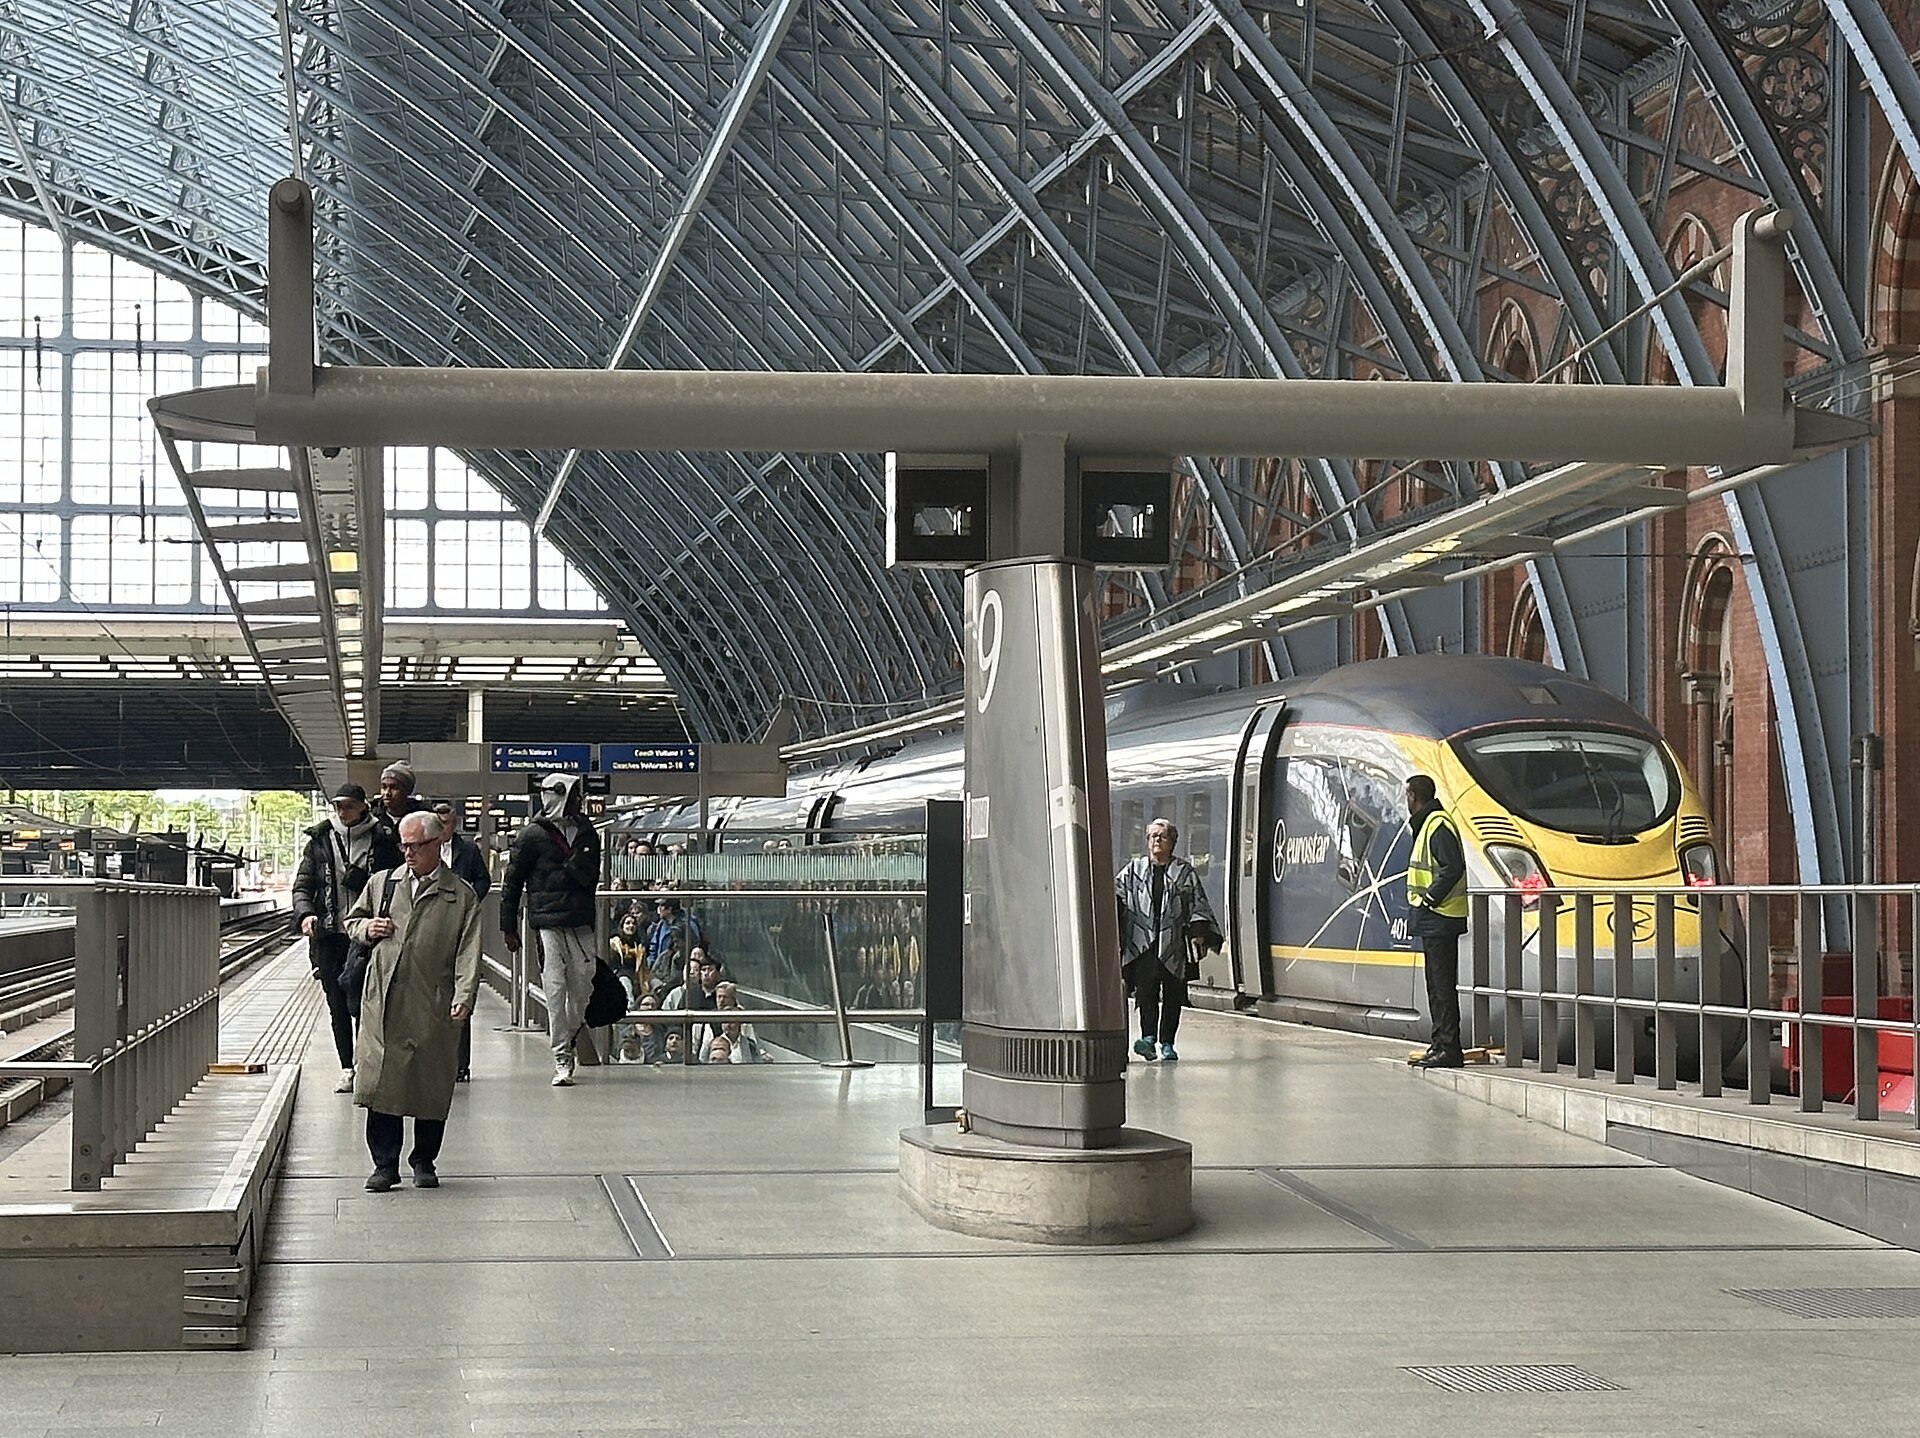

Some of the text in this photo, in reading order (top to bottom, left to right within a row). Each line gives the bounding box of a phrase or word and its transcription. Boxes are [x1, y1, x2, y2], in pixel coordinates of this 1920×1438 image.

[977, 588, 1004, 715] 9
[590, 803, 603, 814] 10
[1286, 832, 1330, 864] eurostar
[1390, 917, 1413, 940] 401
